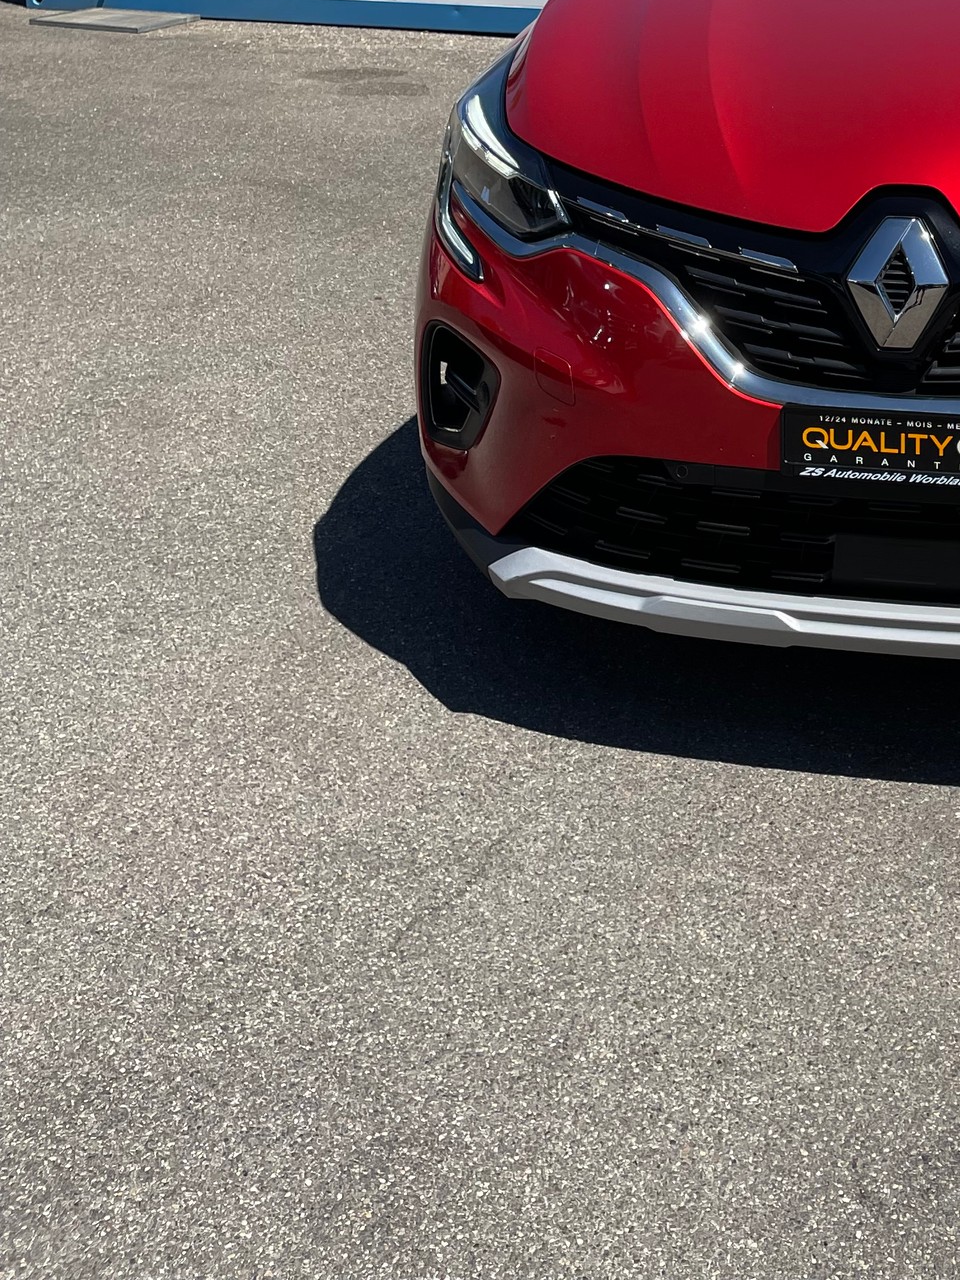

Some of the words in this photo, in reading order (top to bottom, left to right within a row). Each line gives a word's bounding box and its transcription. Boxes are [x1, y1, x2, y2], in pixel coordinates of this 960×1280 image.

[819, 415, 847, 423] 12/24
[851, 416, 893, 426] MONATE
[906, 421, 933, 429] MOIS
[802, 427, 954, 457] QUALITY
[799, 467, 825, 477] ZS
[824, 469, 907, 483] Automobile
